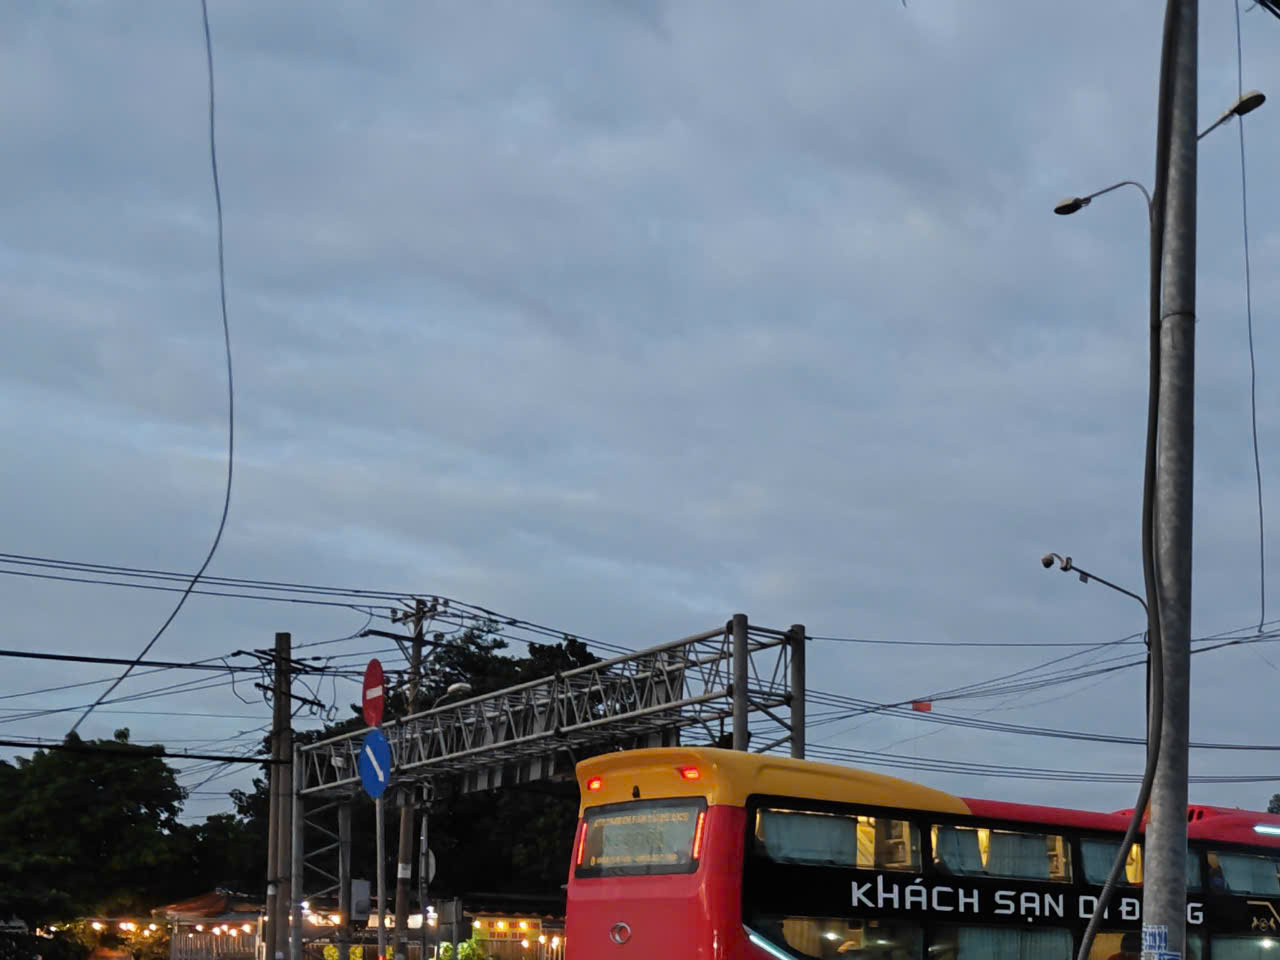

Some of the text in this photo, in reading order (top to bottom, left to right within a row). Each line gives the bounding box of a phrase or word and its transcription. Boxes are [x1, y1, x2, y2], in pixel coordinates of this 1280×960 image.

[851, 874, 979, 913] KHÁCH
[993, 890, 1064, 923] SẠN
[1118, 896, 1204, 925] ĐG
